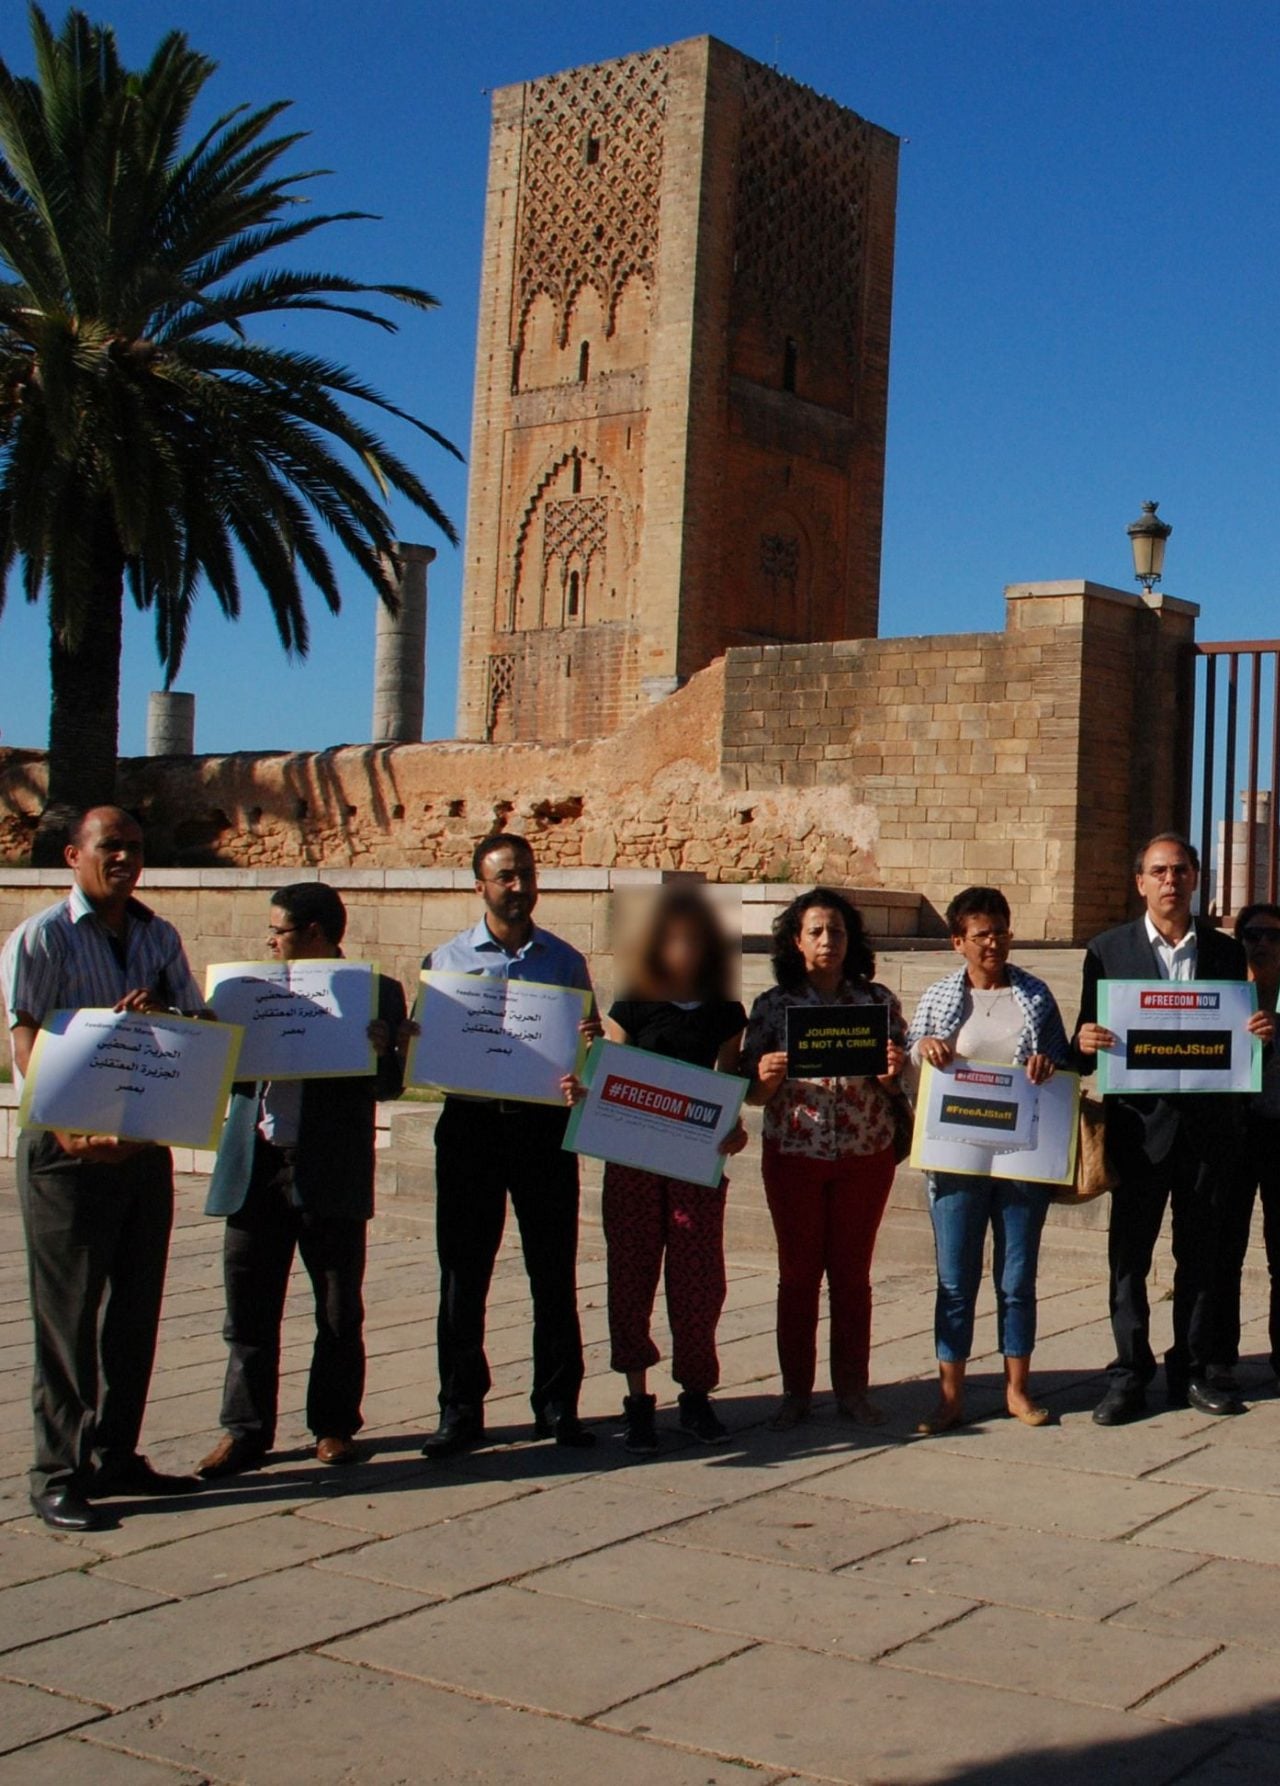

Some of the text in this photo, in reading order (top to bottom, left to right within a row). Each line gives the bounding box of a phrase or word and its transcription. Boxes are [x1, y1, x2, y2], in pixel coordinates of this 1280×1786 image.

[1144, 995, 1218, 1006] #FREEDOM NOW
[805, 1027, 871, 1037] JOURNALISM
[798, 1039, 877, 1049] IS NOT A CRIME
[1134, 1043, 1225, 1055] #FreeAJStaff
[140, 1063, 180, 1079] الجزيرة
[116, 1082, 145, 1093] بمصر
[608, 1082, 683, 1114] #FREEDOM
[685, 1099, 717, 1123] NOW
[946, 1104, 1013, 1120] #FreeAJStaff
